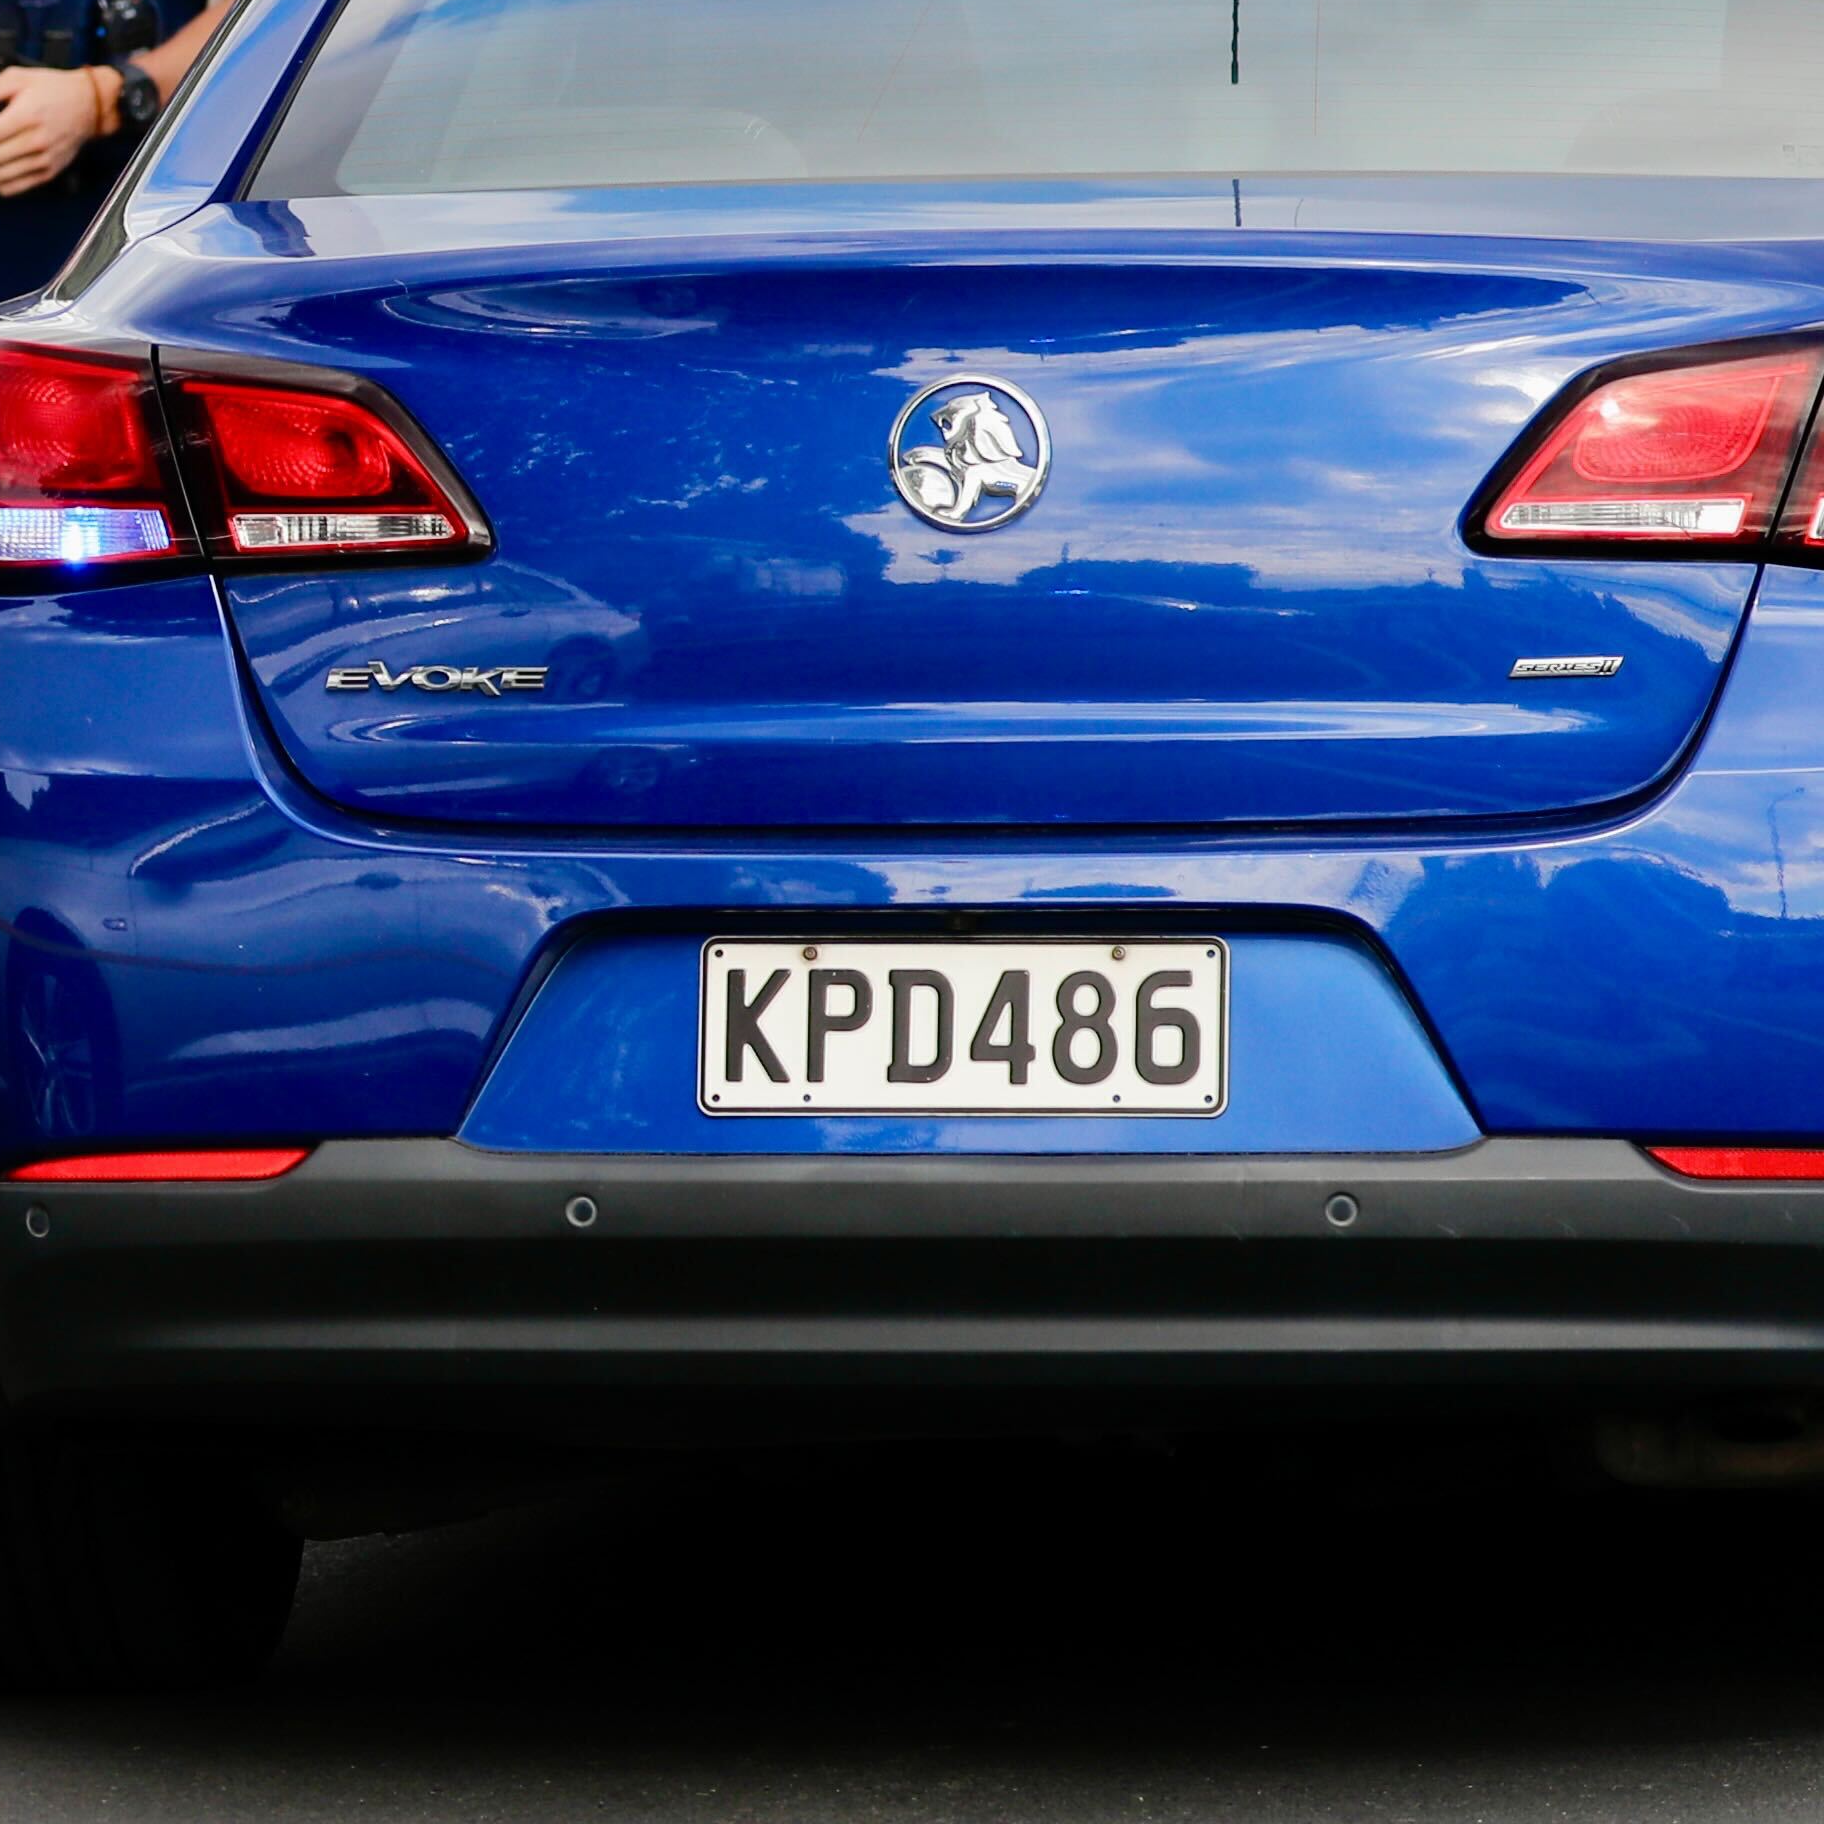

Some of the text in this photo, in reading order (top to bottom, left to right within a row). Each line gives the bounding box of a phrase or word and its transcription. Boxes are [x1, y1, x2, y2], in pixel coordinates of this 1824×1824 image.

[326, 660, 549, 696] EVOKE
[1515, 662, 1602, 674] SERIES
[725, 969, 1201, 1085] KPD486
